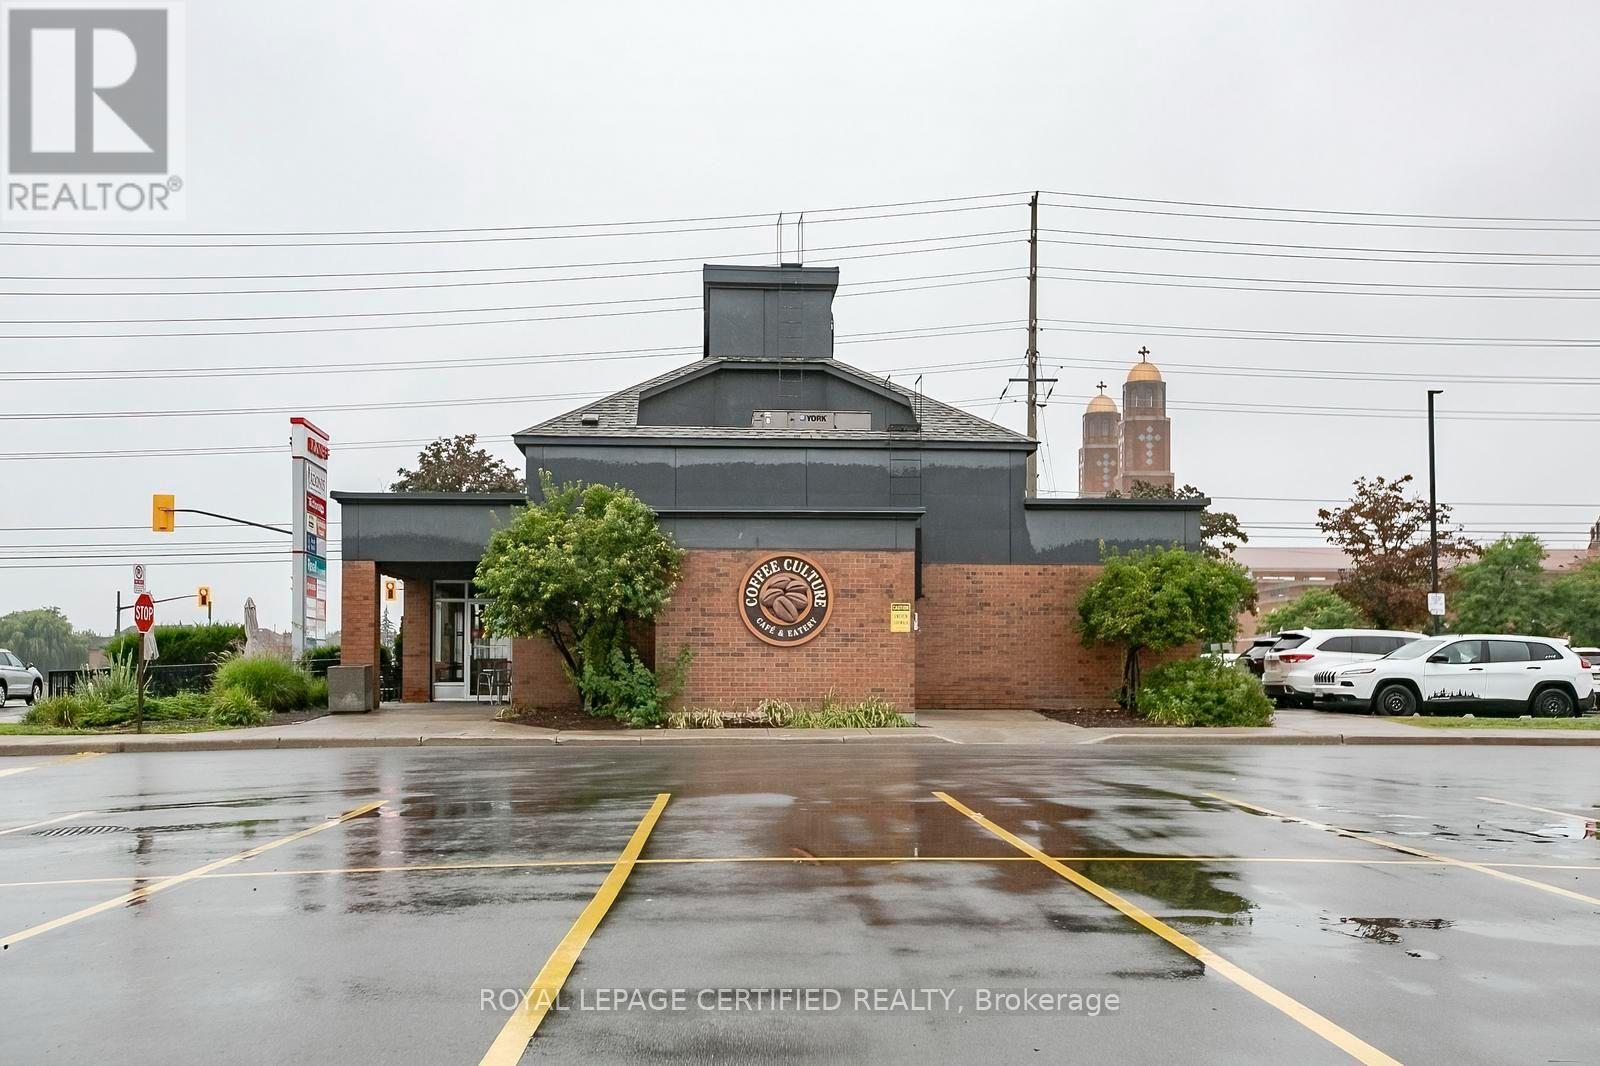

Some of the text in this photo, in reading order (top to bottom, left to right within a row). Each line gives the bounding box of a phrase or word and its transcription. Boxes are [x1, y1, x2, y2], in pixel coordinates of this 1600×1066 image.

[745, 558, 827, 608] COFFEE CULTURE
[135, 605, 154, 621] STOP
[777, 629, 784, 637] &
[787, 616, 818, 637] EATERY
